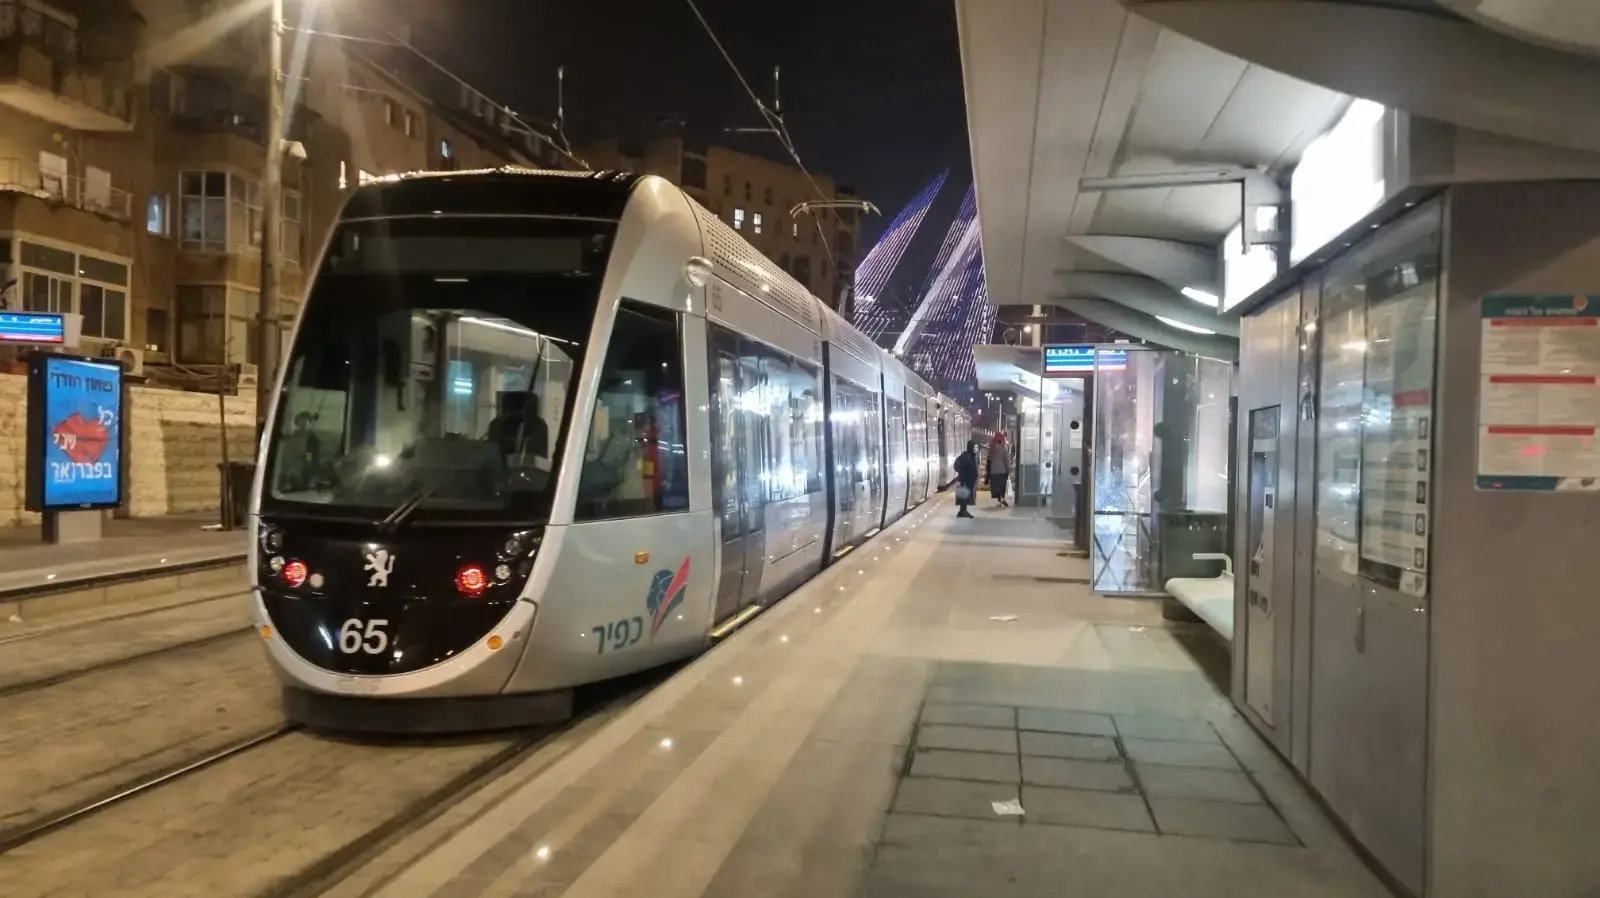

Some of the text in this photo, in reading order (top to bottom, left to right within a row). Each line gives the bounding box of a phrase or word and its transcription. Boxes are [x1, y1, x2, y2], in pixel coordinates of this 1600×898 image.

[98, 405, 113, 425] כל
[53, 432, 77, 451] שני
[51, 462, 112, 480] בפברואר
[340, 617, 389, 656] 65
[592, 616, 643, 655] כפיר
